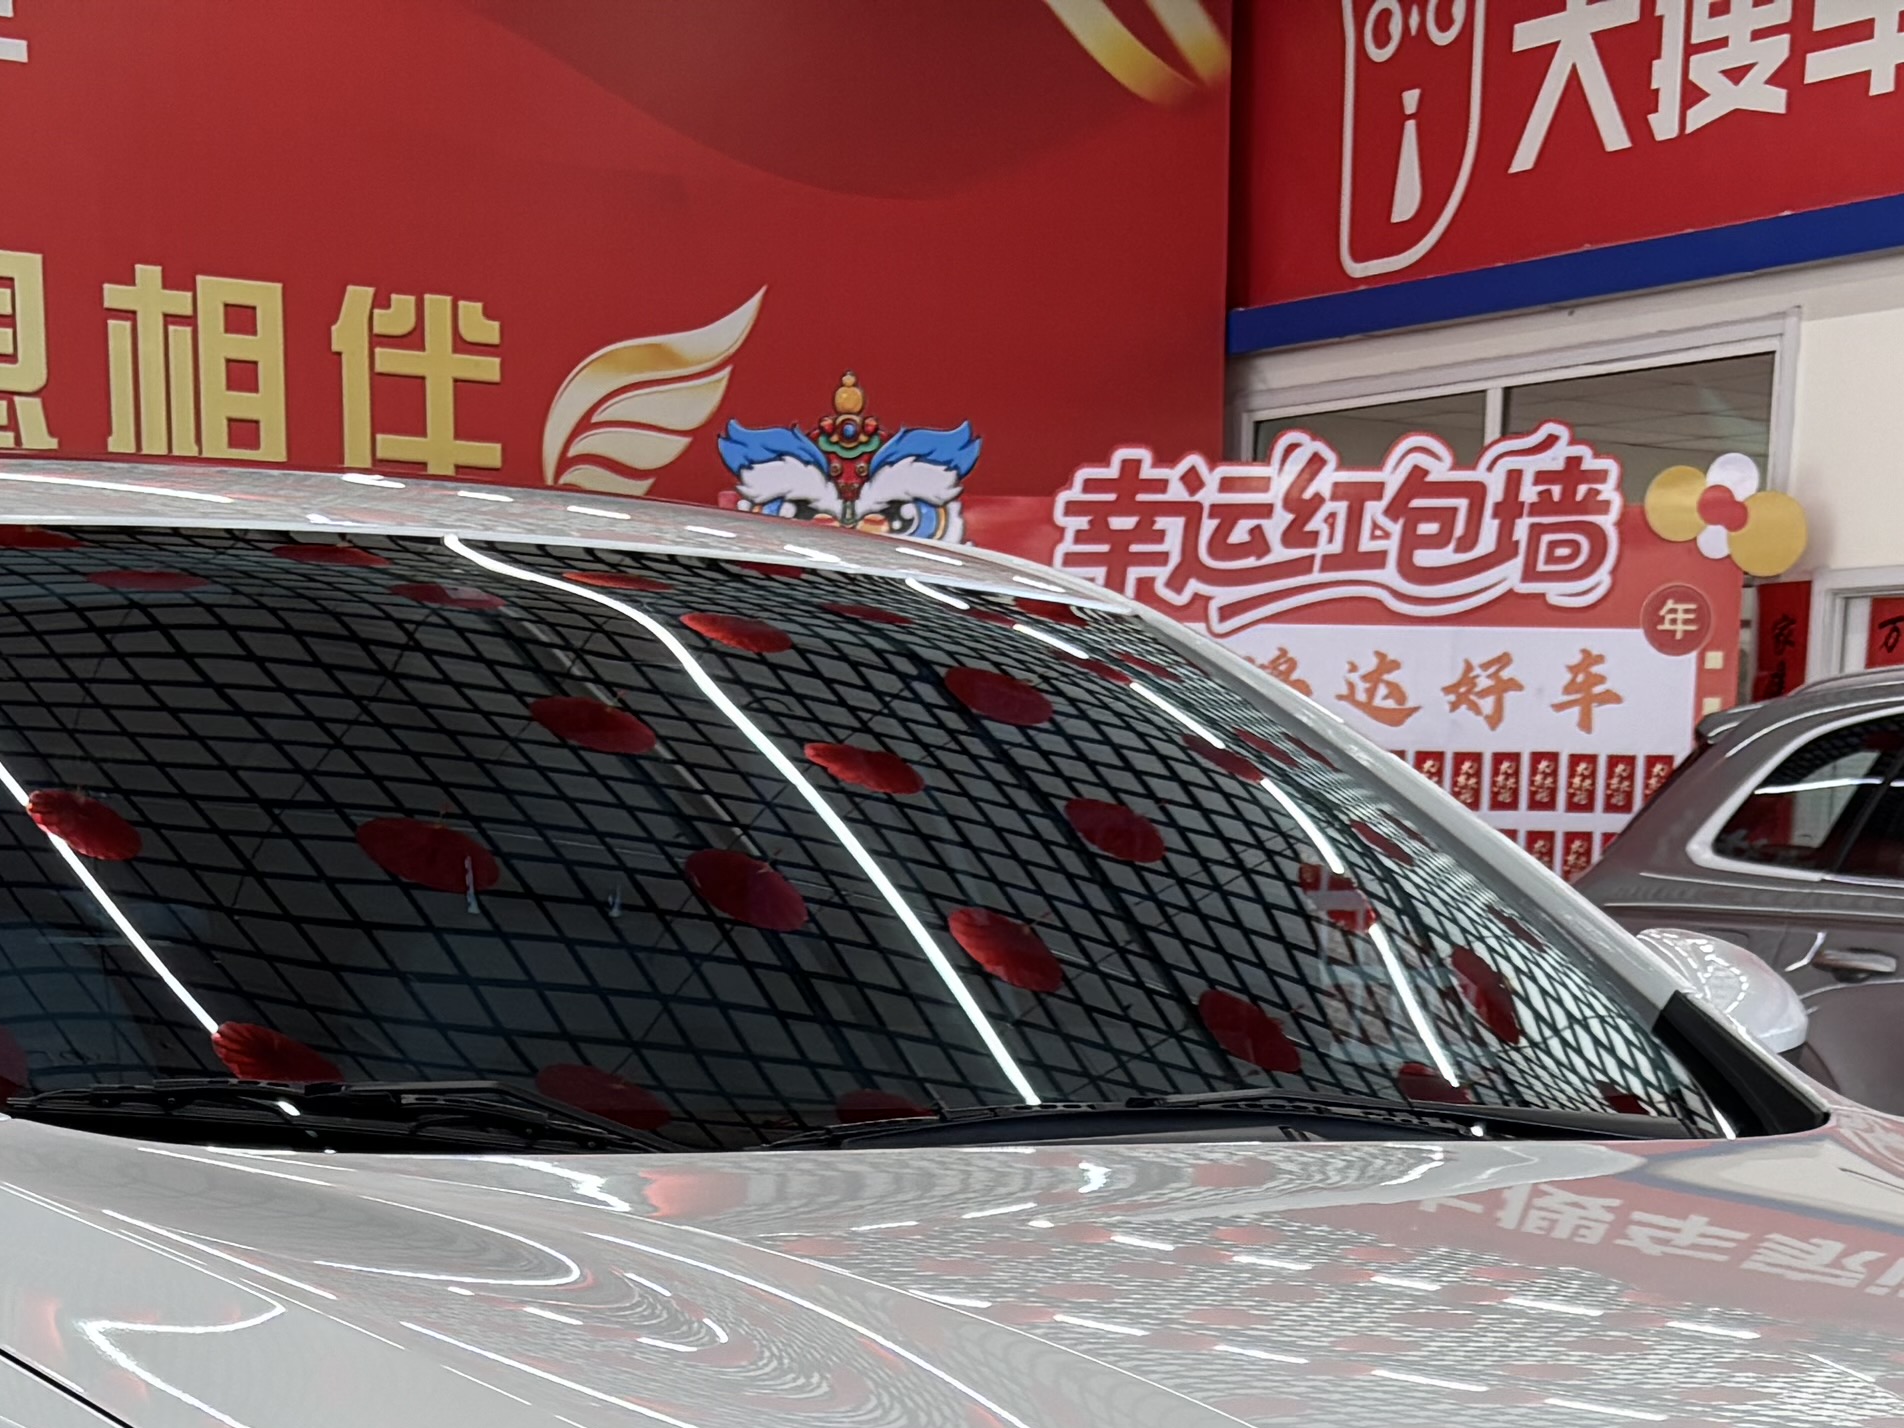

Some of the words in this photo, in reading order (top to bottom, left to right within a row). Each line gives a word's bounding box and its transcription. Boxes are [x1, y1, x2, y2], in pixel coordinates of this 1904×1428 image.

[1059, 420, 1624, 605] 幸运红包墙
[1658, 599, 1699, 640] 年
